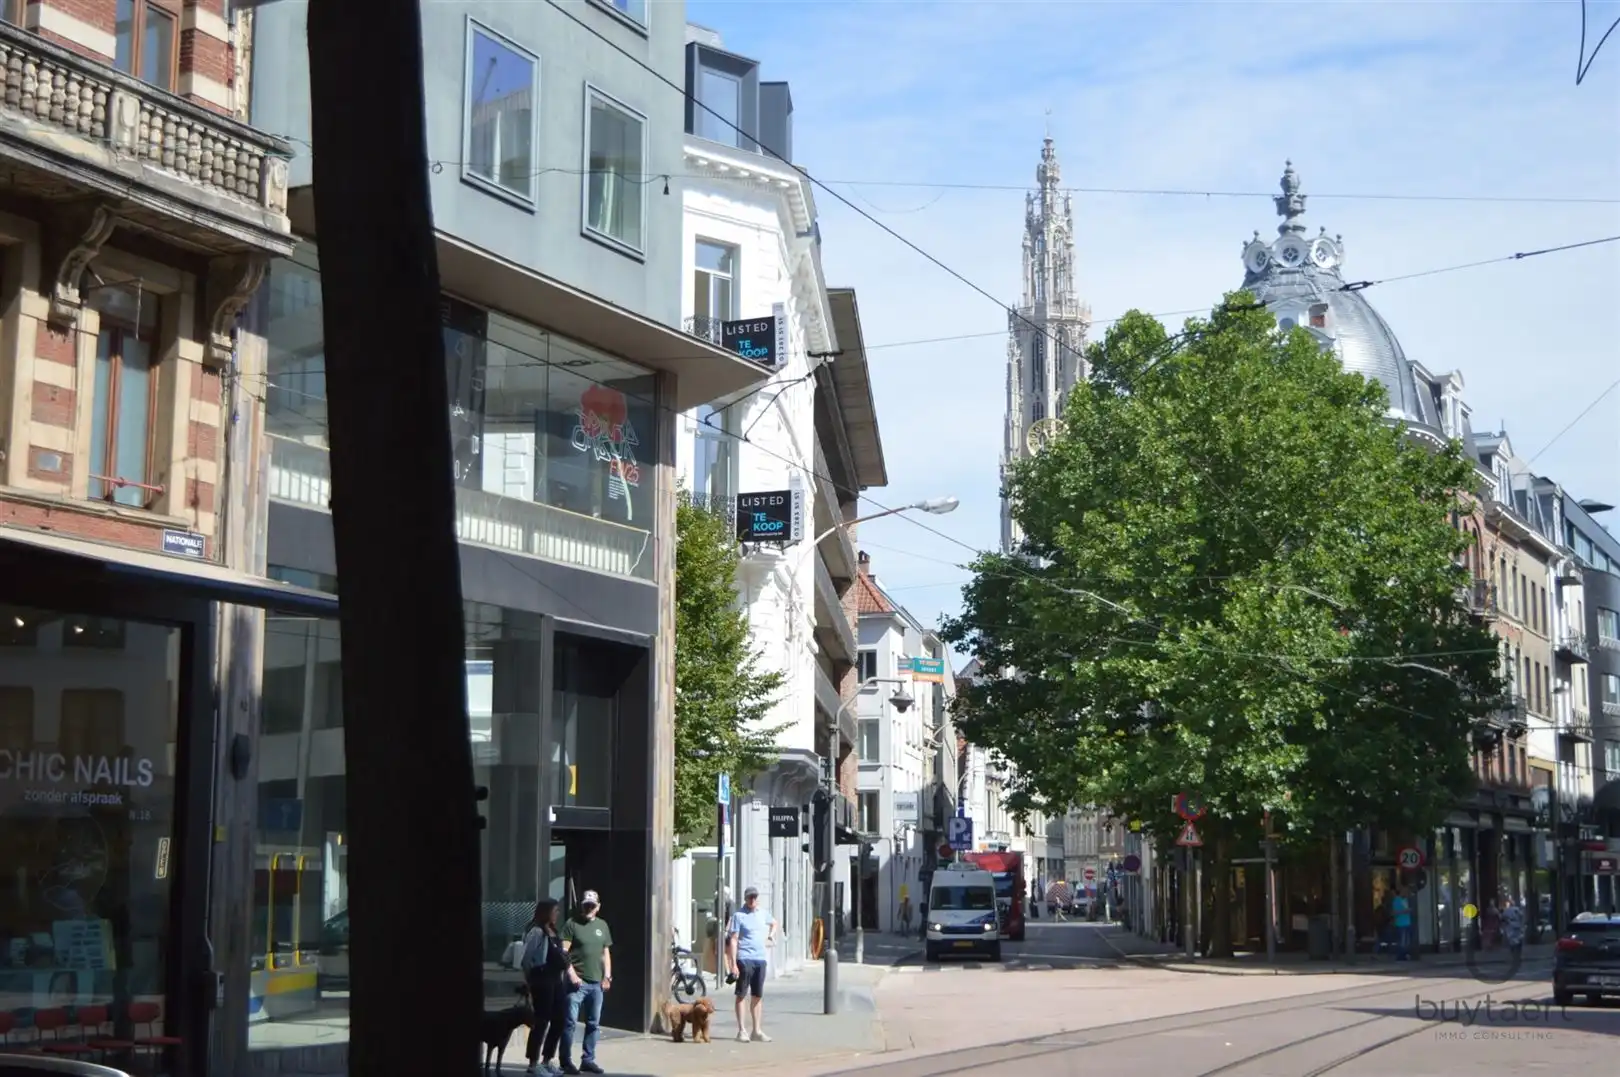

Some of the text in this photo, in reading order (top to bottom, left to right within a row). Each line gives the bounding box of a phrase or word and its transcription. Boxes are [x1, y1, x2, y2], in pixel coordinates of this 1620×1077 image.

[726, 322, 768, 336] LISTED
[738, 339, 752, 349] TE
[738, 347, 769, 358] KOOP
[741, 495, 785, 507] LISTED
[753, 512, 767, 522] TE
[753, 521, 785, 532] KOOP
[165, 534, 203, 549] NATIONALE
[0, 749, 154, 787] CHIC NAILS
[24, 788, 123, 806] zonder afspraak
[780, 823, 787, 831] K
[949, 817, 968, 842] P
[1401, 851, 1419, 865] 20
